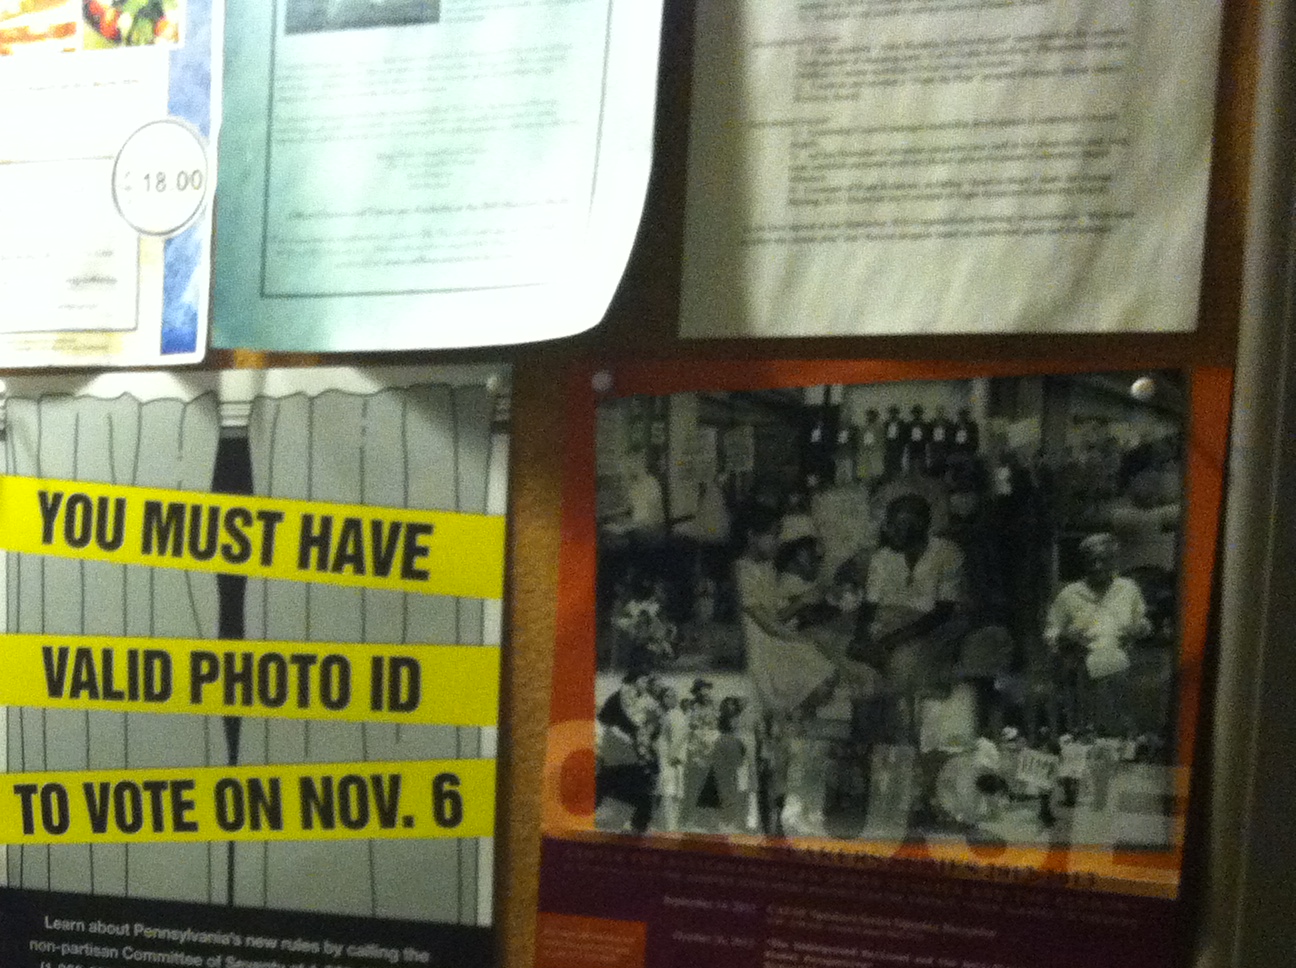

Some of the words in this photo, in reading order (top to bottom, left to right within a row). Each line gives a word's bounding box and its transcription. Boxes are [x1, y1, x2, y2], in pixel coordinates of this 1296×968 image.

[36, 489, 127, 552] YOU
[140, 500, 285, 568] MUST
[296, 513, 436, 583] HAVE
[41, 645, 173, 704] VALID
[189, 650, 352, 711] PHOTO
[370, 654, 422, 715] ID
[13, 782, 71, 836] TO
[82, 779, 200, 835] VOTE
[213, 775, 284, 834] ON
[297, 772, 416, 832] NOV.
[430, 771, 464, 831] 6
[29, 939, 120, 959] non-partisan
[122, 946, 204, 968] Committee
[206, 954, 223, 968] of
[44, 915, 86, 932] Learn
[88, 920, 131, 936] about
[133, 923, 242, 946] Pennsylvania's
[245, 936, 278, 949] new
[280, 938, 321, 955] rules
[323, 940, 345, 958] by
[403, 947, 431, 963] the
